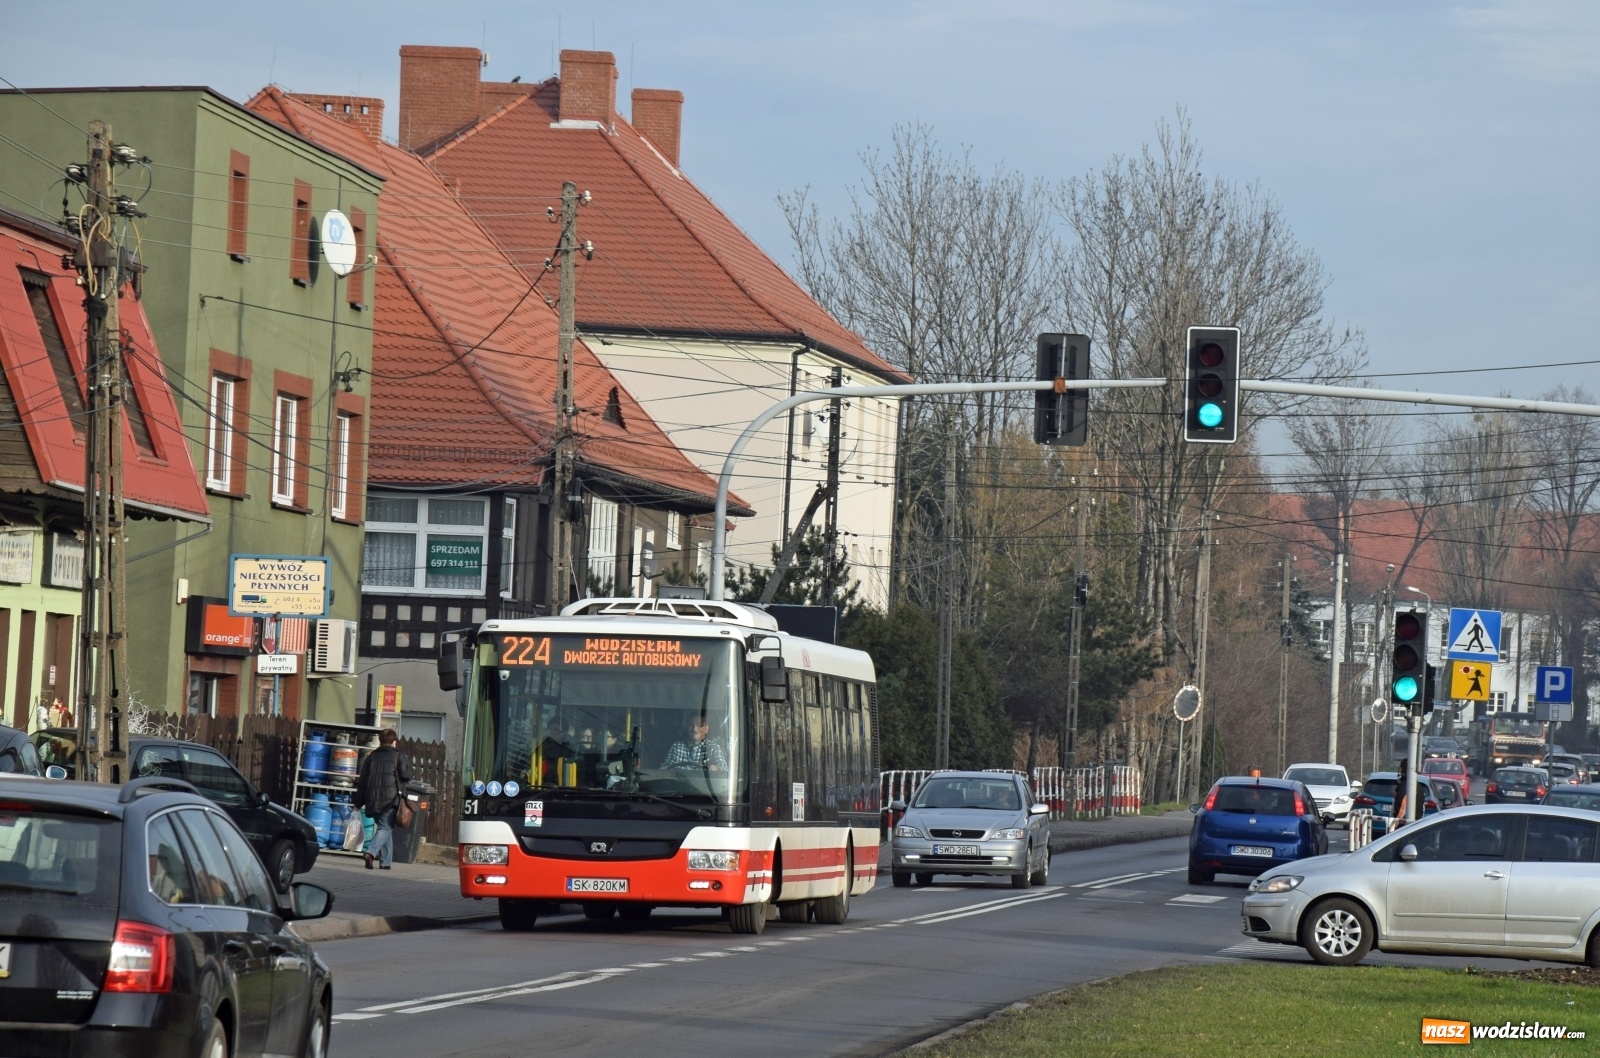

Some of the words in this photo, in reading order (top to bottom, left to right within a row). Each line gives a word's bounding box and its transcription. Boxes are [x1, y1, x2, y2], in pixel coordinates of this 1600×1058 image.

[430, 545, 480, 554] SPRZEDAM
[258, 562, 304, 572] WYWÓZ
[430, 559, 447, 568] 697
[448, 559, 464, 568] 314
[239, 572, 321, 582] NIECZYSTOŚCI
[250, 582, 309, 591] PŁYNNYCH
[205, 633, 240, 645] orange
[502, 636, 550, 666] 224
[585, 638, 681, 653] WODZISŁAW
[563, 650, 619, 665] DWORZEC
[622, 652, 701, 667] AUTOBUSOWY
[1543, 670, 1565, 698] P
[464, 799, 478, 815] 51
[938, 846, 955, 854] SWD
[957, 846, 976, 855] 28EL
[1235, 846, 1249, 854] SWD
[1250, 847, 1272, 856] 30306
[573, 879, 588, 891] SK
[592, 880, 626, 891] 820KM
